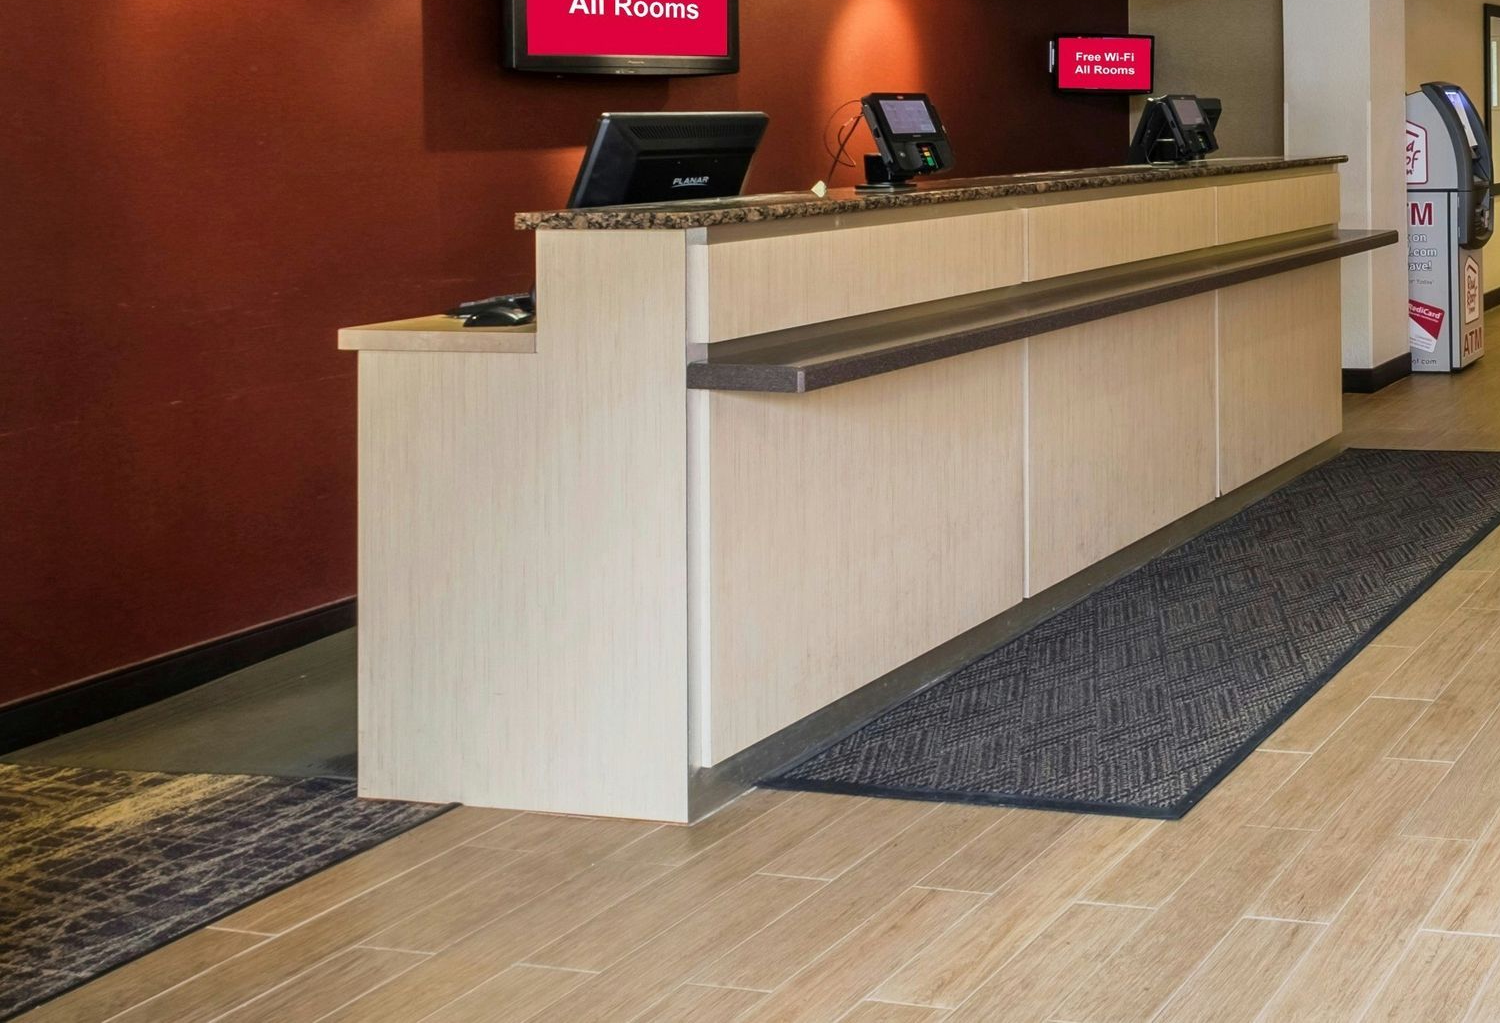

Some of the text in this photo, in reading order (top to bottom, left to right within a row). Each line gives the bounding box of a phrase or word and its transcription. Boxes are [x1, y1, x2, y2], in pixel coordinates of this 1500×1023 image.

[1075, 52, 1135, 62] Free Wi-Fi
[1075, 65, 1135, 75] All Rooms
[672, 176, 710, 185] PLANAR
[1412, 233, 1428, 242] on
[1408, 246, 1437, 257] .com
[1408, 261, 1433, 272] ave!
[1463, 327, 1483, 357] ATM
